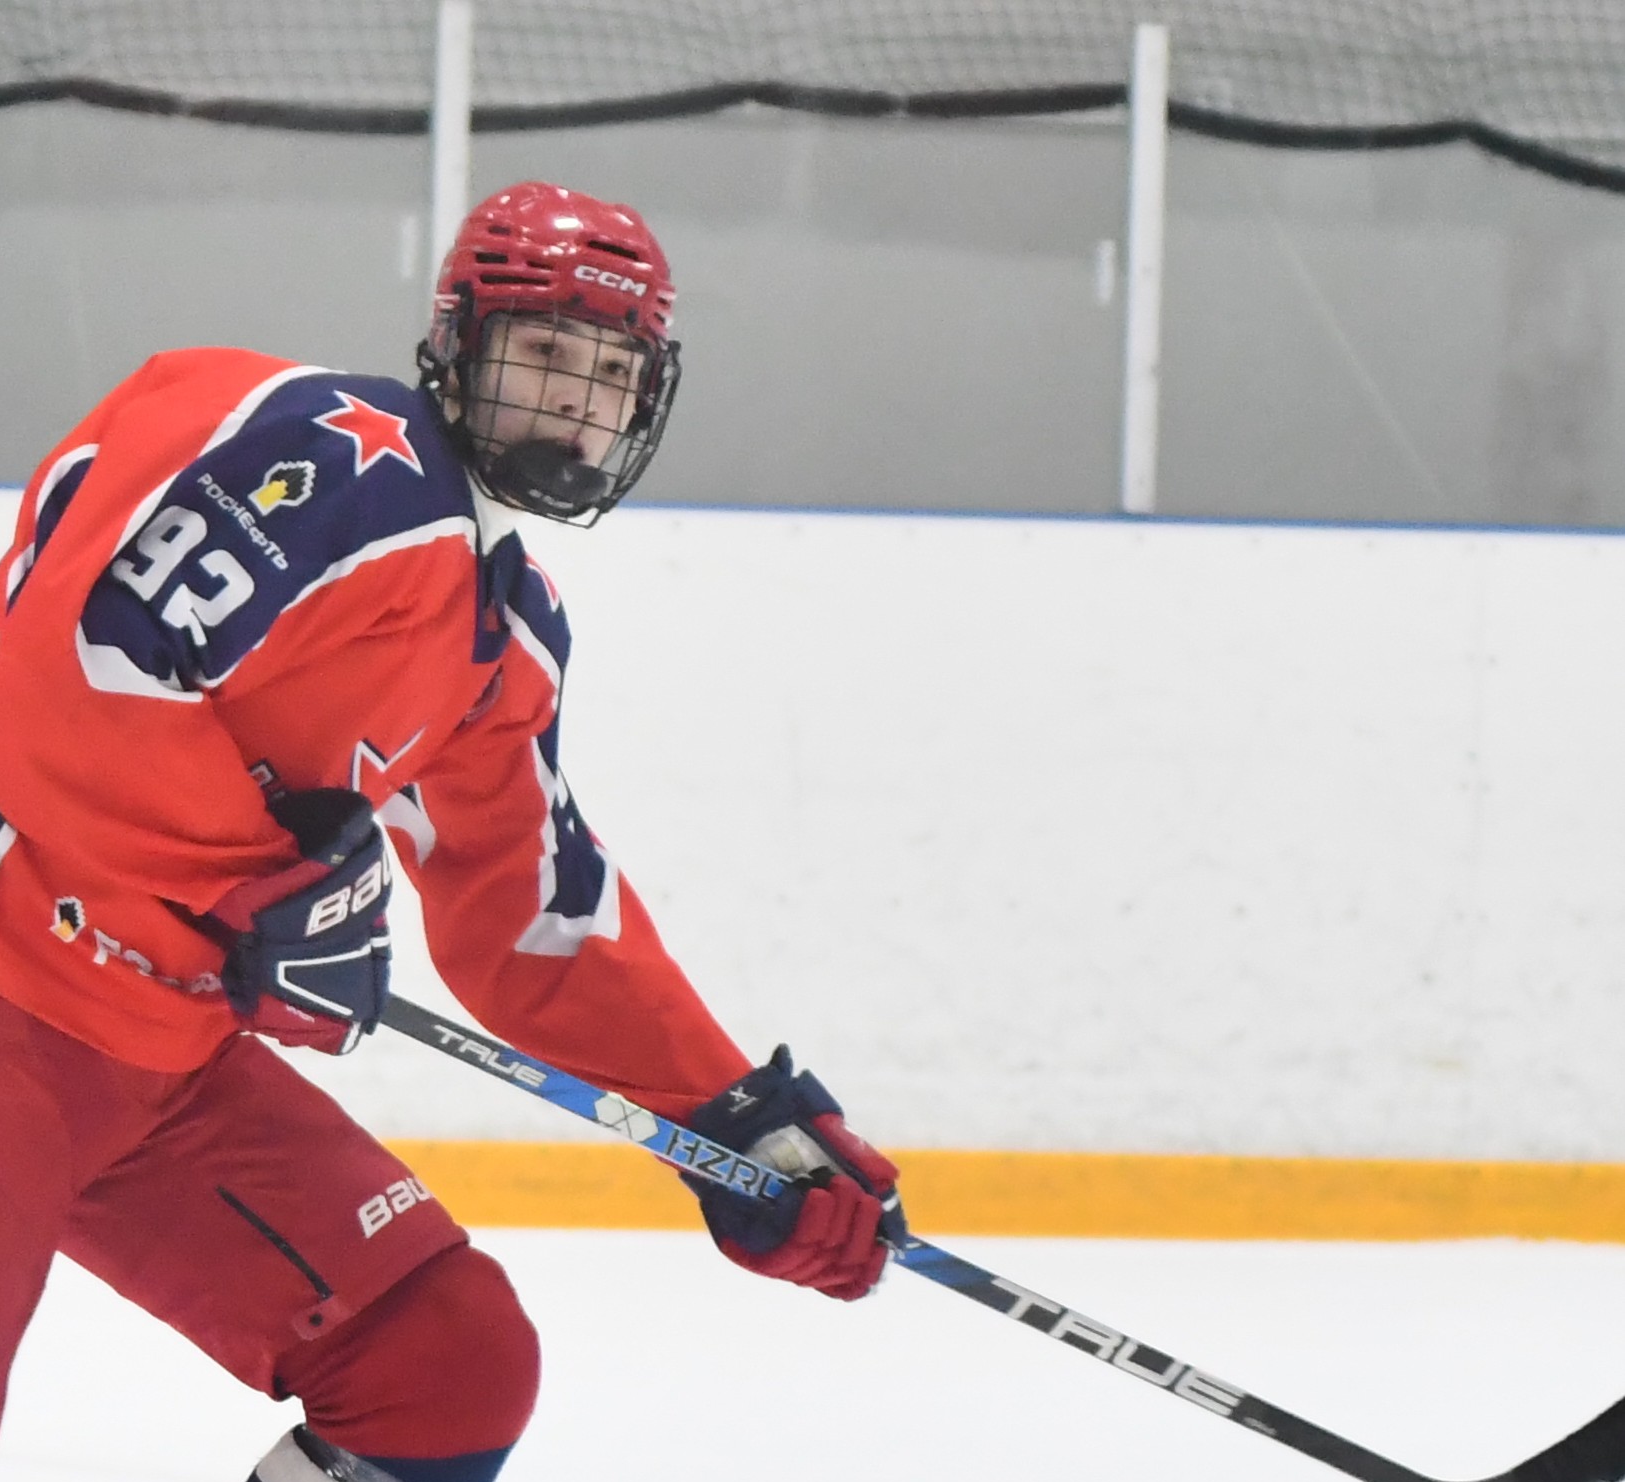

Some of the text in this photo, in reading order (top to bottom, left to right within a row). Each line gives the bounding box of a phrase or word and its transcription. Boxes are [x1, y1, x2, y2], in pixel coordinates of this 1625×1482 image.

[574, 265, 647, 297] CCM
[197, 472, 289, 571] РОСНЕФТЬ
[111, 505, 255, 647] 92
[433, 1023, 548, 1089] TRUE
[991, 1277, 1249, 1417] TRUE
